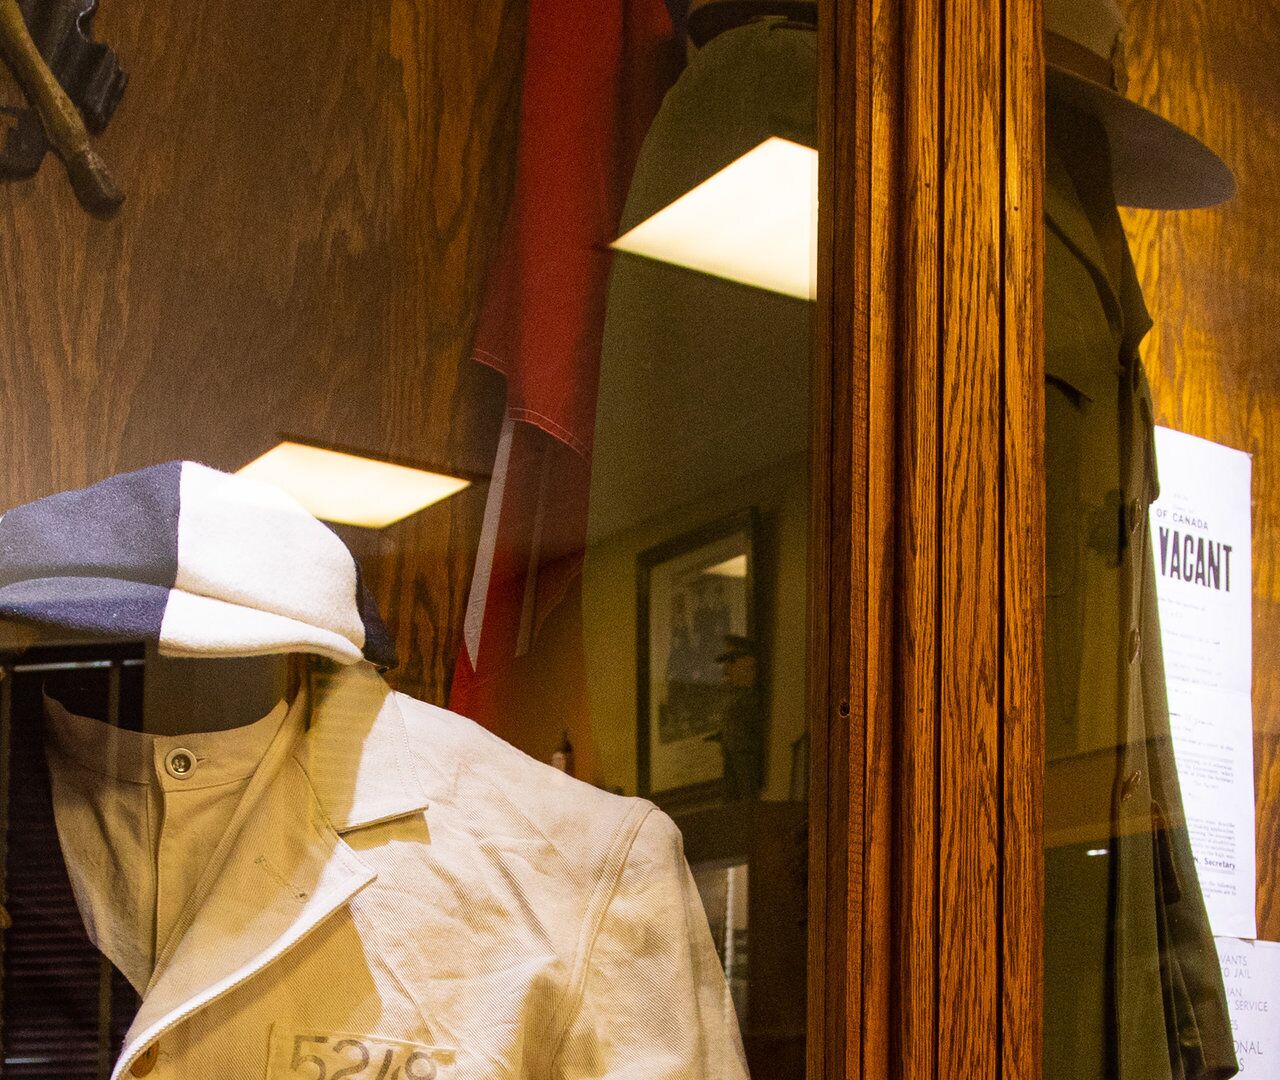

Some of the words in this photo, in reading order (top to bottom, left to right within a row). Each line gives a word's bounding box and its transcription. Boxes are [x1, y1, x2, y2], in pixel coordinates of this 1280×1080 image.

[1156, 508, 1167, 519] OF
[1172, 512, 1209, 531] CANADA
[1159, 525, 1233, 593] VACANT
[1204, 857, 1235, 870] Secretary
[1221, 955, 1247, 967] VANTS
[1234, 969, 1252, 979] JAIL
[1235, 1000, 1268, 1012] SERVICE
